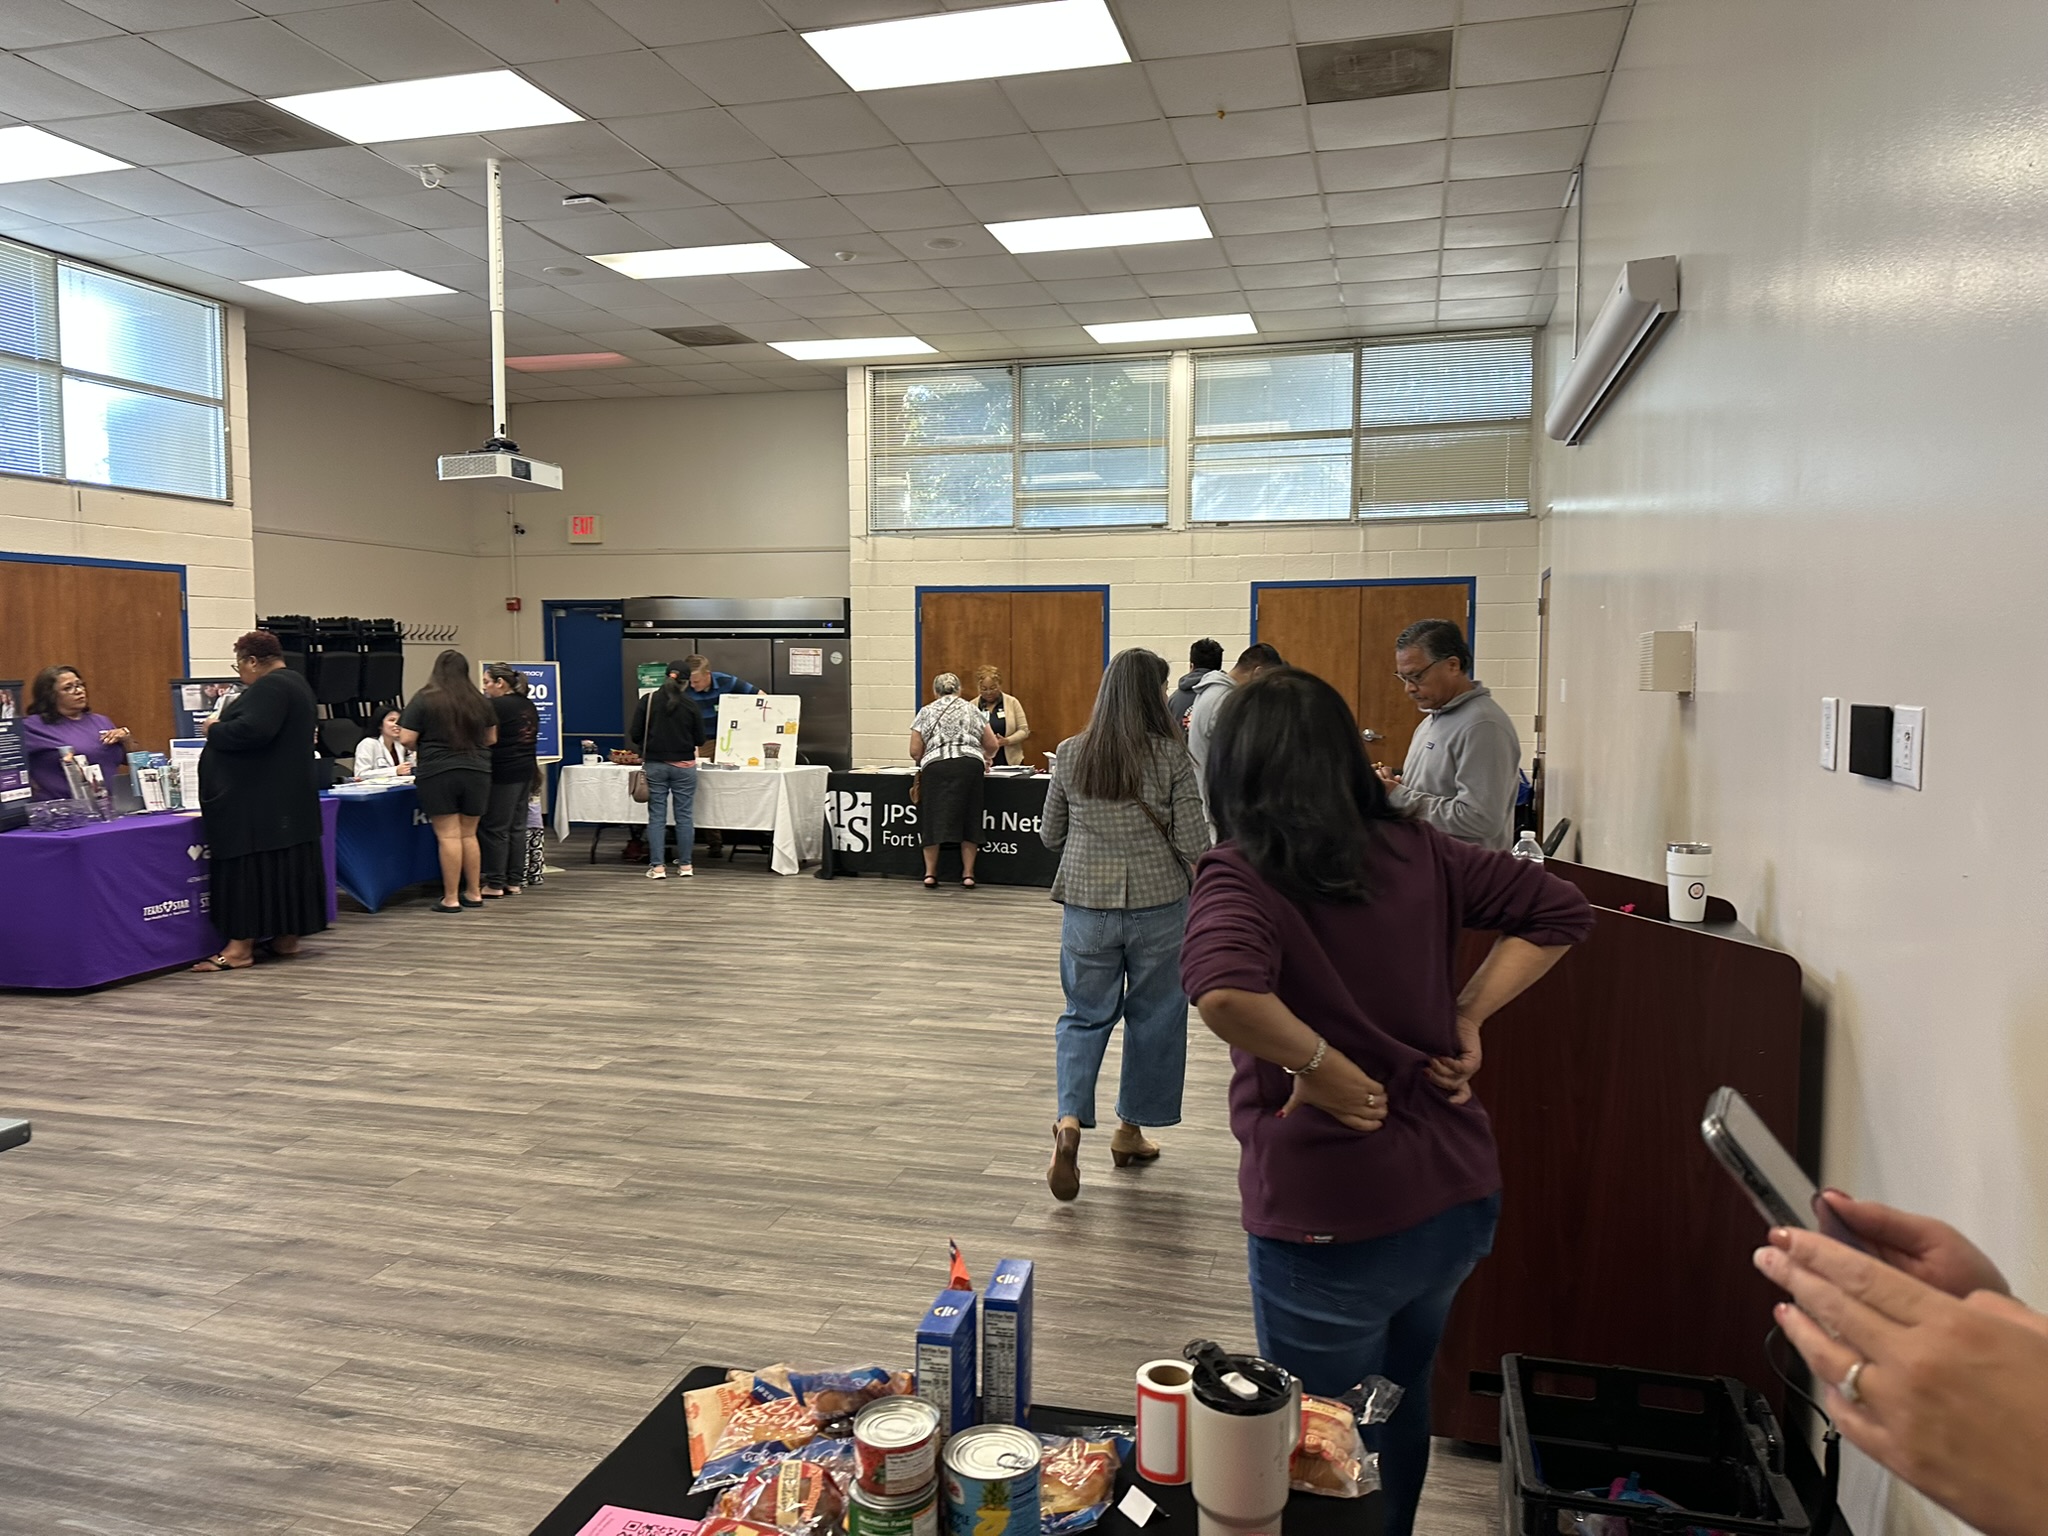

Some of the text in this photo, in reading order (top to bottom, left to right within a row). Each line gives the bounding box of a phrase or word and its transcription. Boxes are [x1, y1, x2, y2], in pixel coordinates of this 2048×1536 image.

[573, 516, 594, 535] EXIT
[881, 803, 918, 827] JPS
[882, 830, 914, 847] Fort
[977, 839, 1018, 854] exas
[172, 899, 190, 910] STAR
[729, 1409, 808, 1430] Honey
